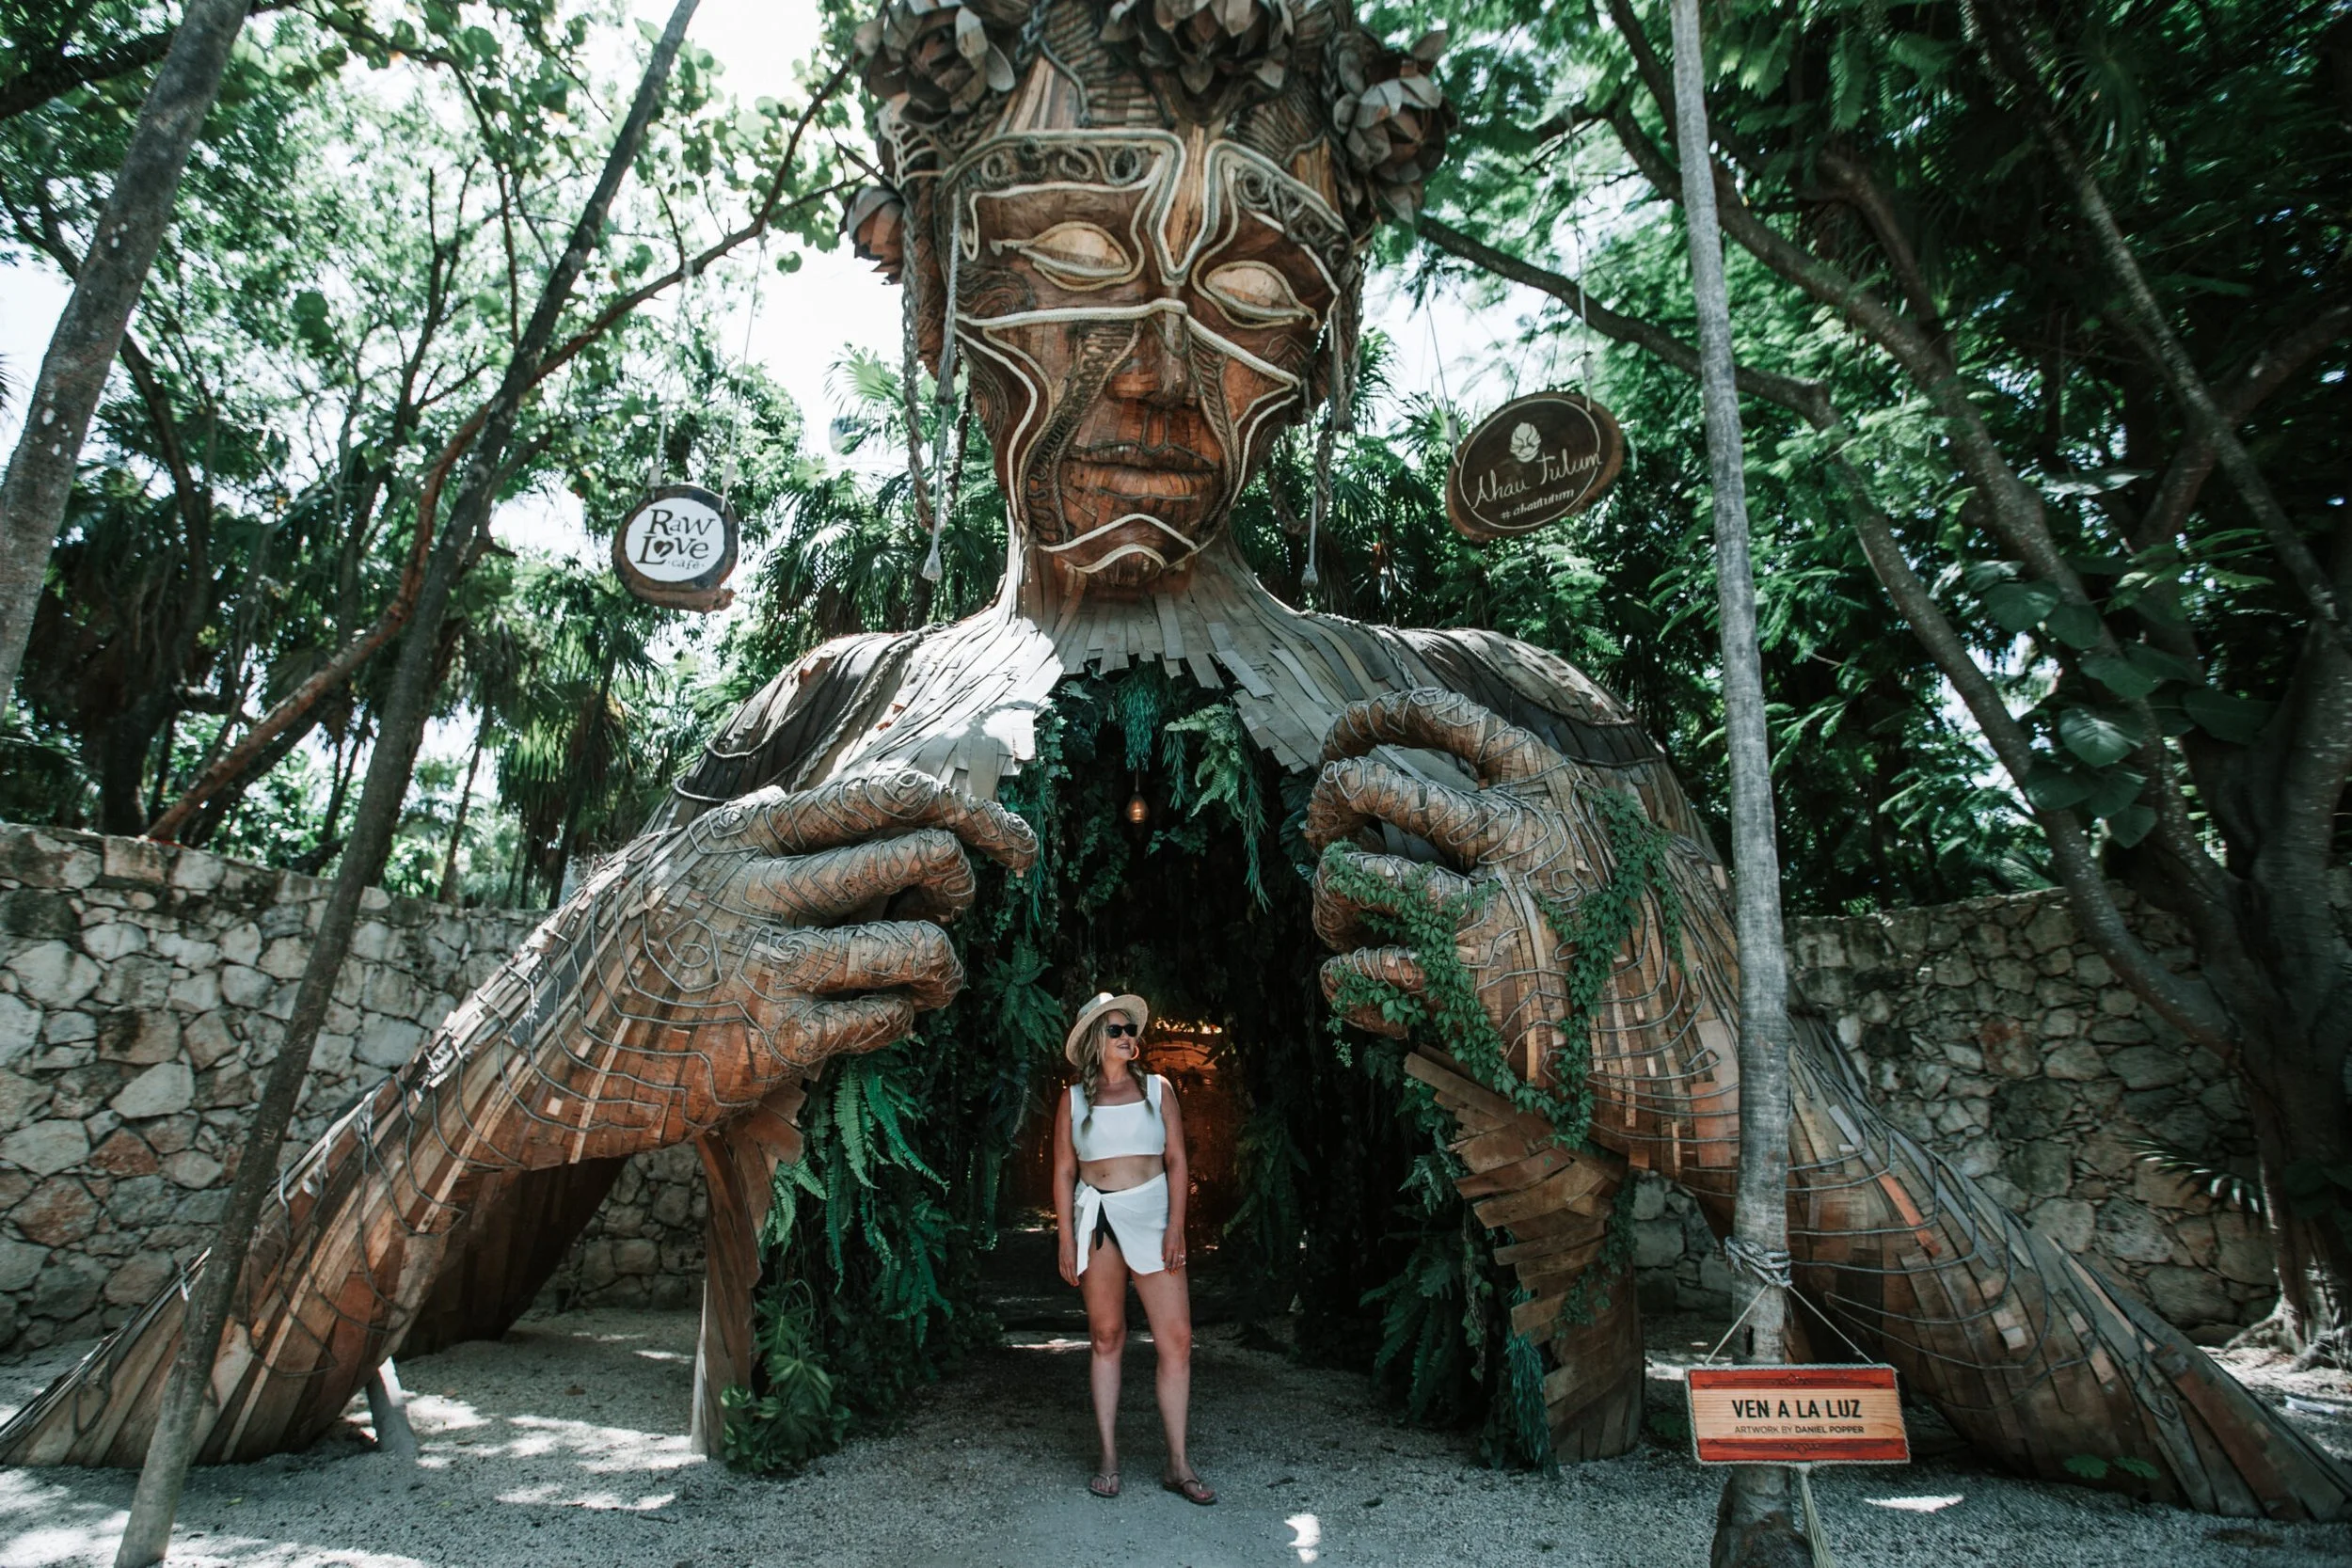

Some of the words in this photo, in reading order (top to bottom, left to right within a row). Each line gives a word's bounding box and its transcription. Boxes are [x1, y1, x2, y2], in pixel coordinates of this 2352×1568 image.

[1470, 469, 1532, 509] Ahau
[1535, 448, 1602, 485] Tulum
[644, 509, 716, 536] Raw
[1731, 1399, 1771, 1418] VEN
[1777, 1399, 1790, 1418] A
[1796, 1399, 1820, 1418] LA
[1825, 1399, 1863, 1418] LUZ
[1734, 1425, 1779, 1434] ARTWORK
[1782, 1425, 1793, 1434] BY
[1795, 1425, 1827, 1434] DANIEL
[1829, 1425, 1865, 1434] POPPER
